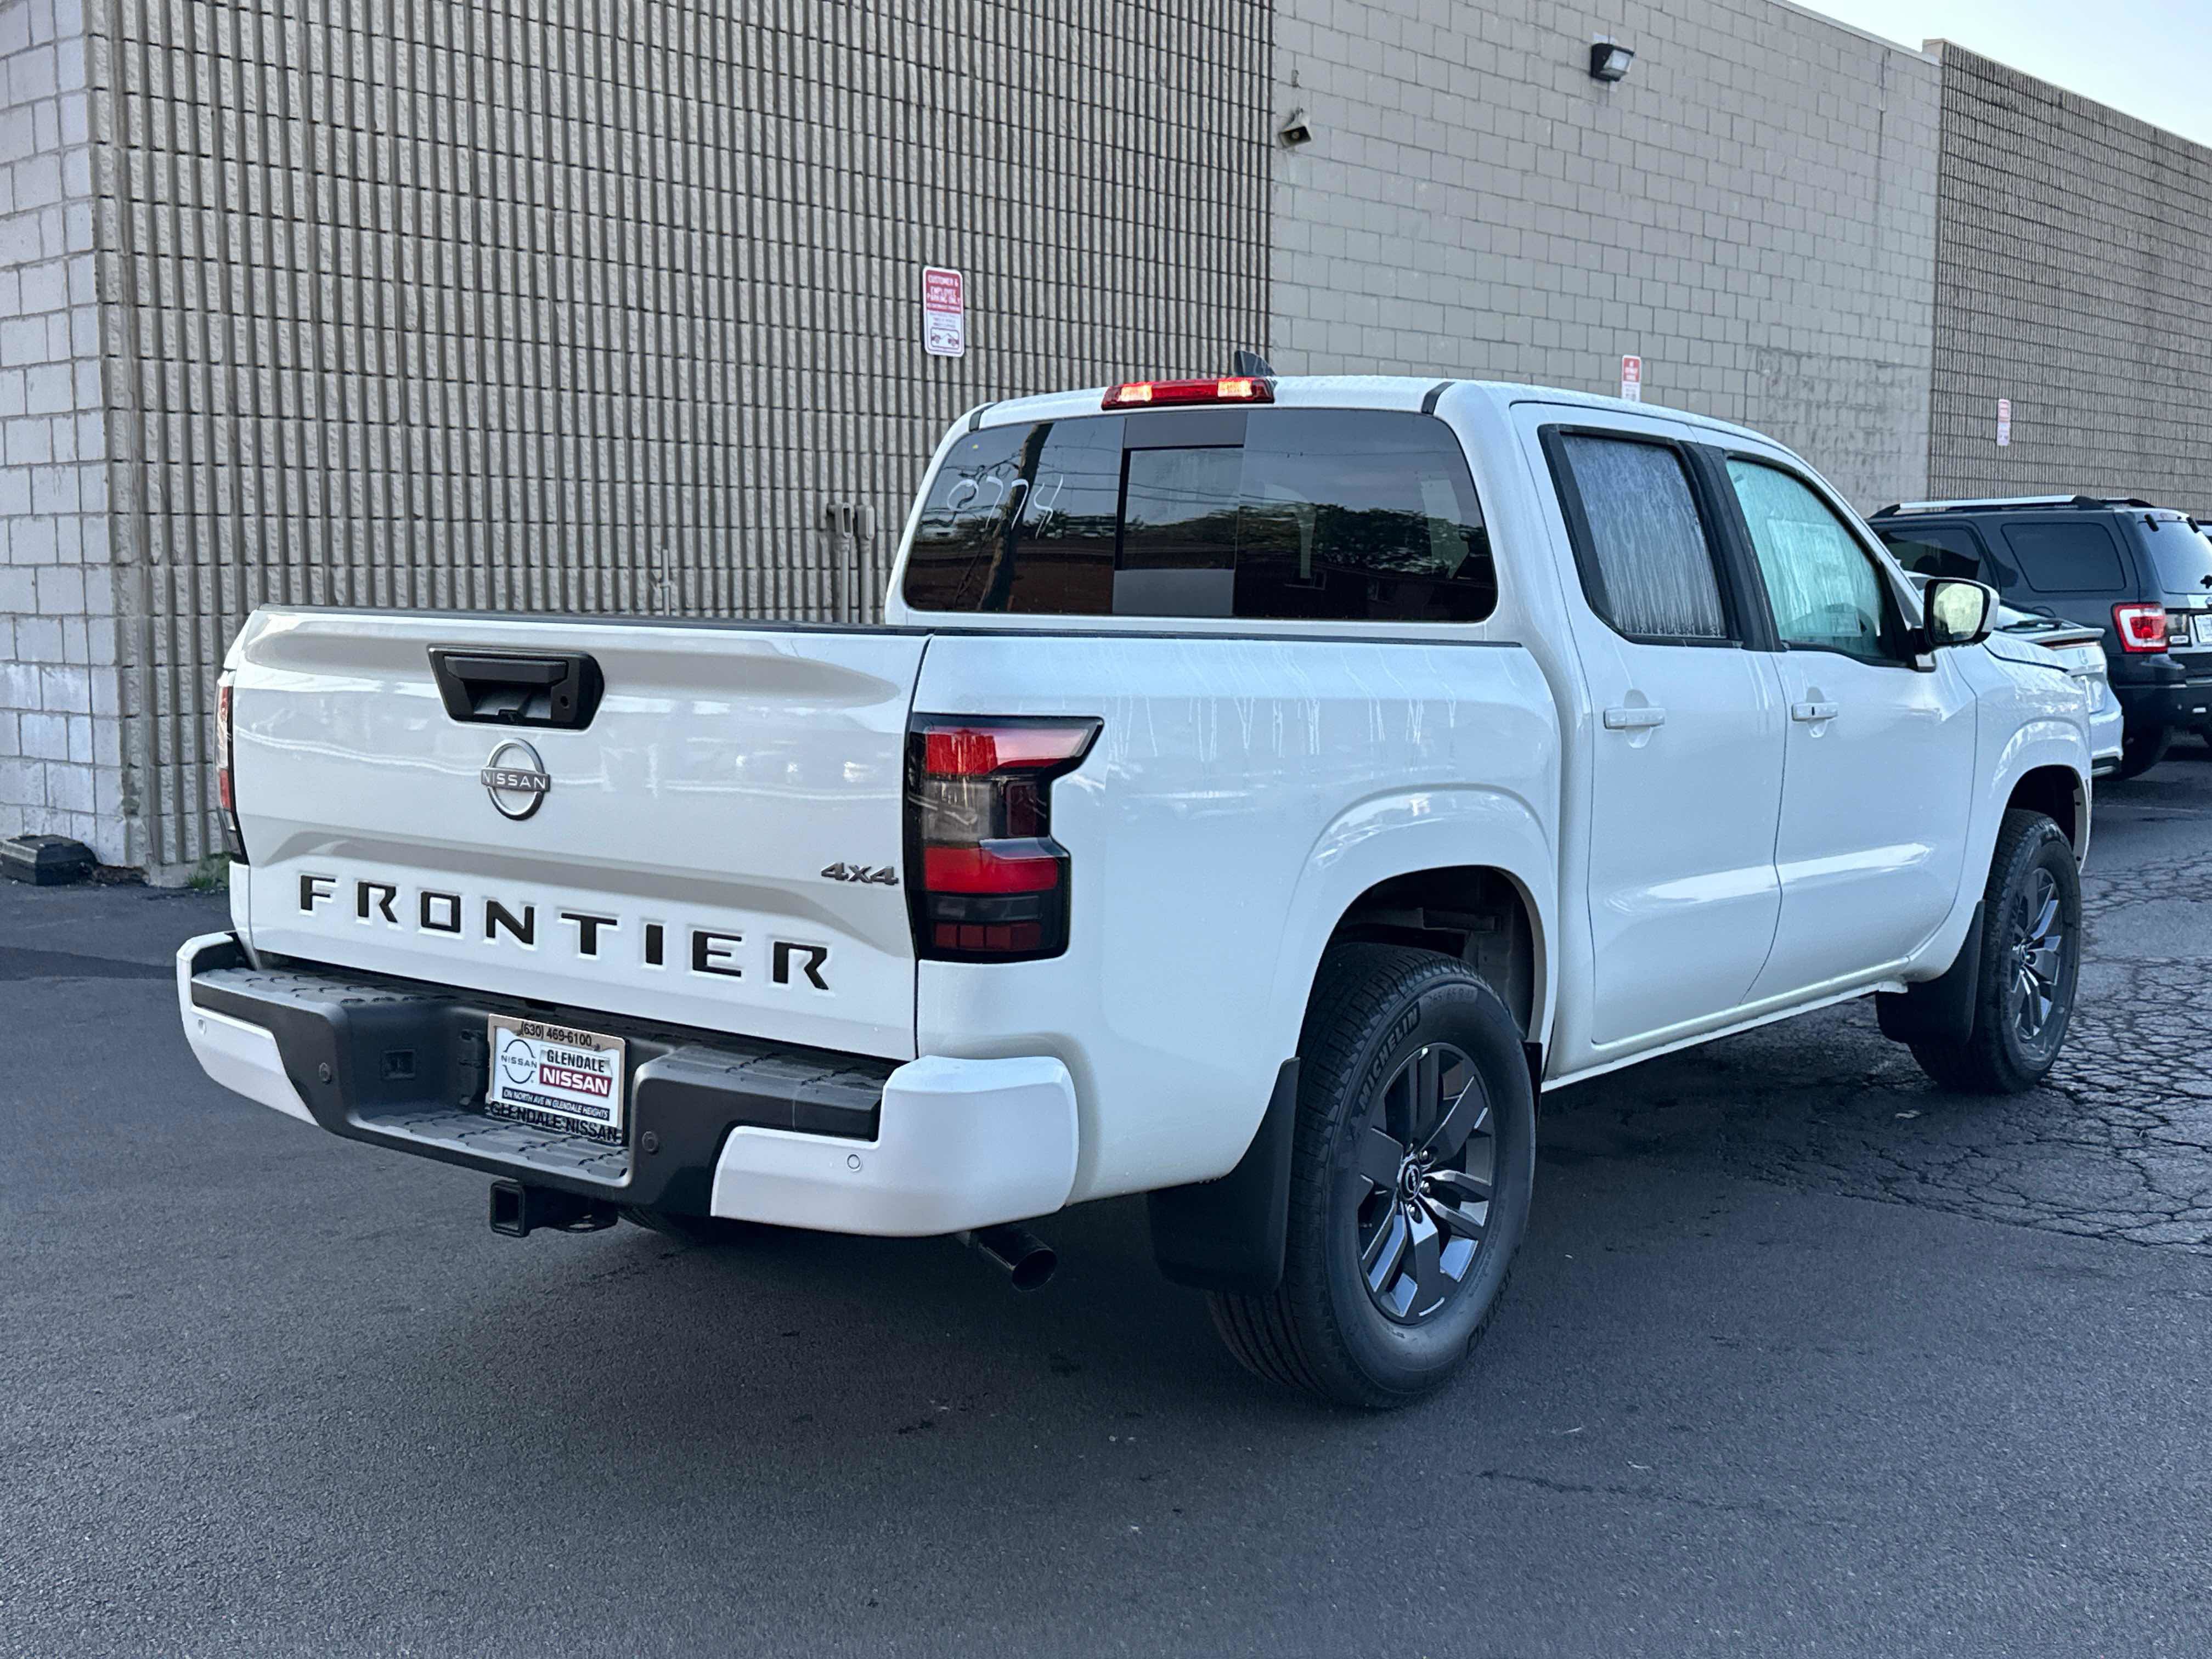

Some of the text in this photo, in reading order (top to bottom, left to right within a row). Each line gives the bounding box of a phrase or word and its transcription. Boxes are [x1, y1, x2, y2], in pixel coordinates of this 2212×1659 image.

[482, 770, 546, 789] NISSAN
[300, 875, 829, 990] FRONTIER
[521, 1021, 592, 1047] (630) 469-6100
[501, 1054, 537, 1068] NISSAN
[547, 1049, 605, 1073] GLENDALE
[1358, 1008, 1418, 1111] MICHELIN
[543, 1067, 608, 1095] NISSAN
[504, 1089, 512, 1097] ON
[513, 1091, 533, 1102] NORTH
[534, 1095, 544, 1105] AVE
[552, 1098, 582, 1113] GLENDALE
[583, 1104, 608, 1119] HEIGHTS
[492, 1101, 618, 1143] GLENDALE NISSAN
